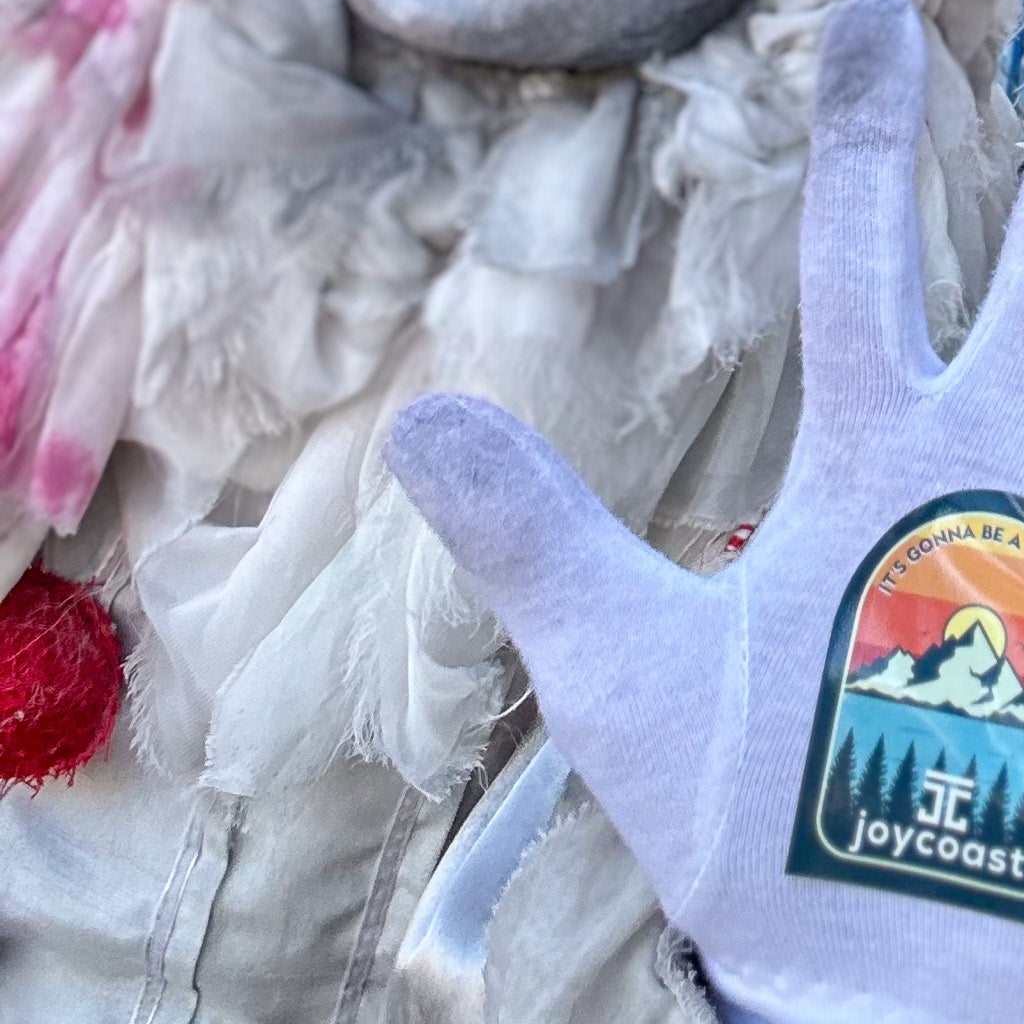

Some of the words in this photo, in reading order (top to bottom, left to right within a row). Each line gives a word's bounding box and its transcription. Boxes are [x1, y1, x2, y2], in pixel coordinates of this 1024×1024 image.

[878, 560, 907, 594] IT'S
[906, 525, 975, 562] GONNA
[982, 525, 1004, 542] BE
[1008, 534, 1021, 550] A
